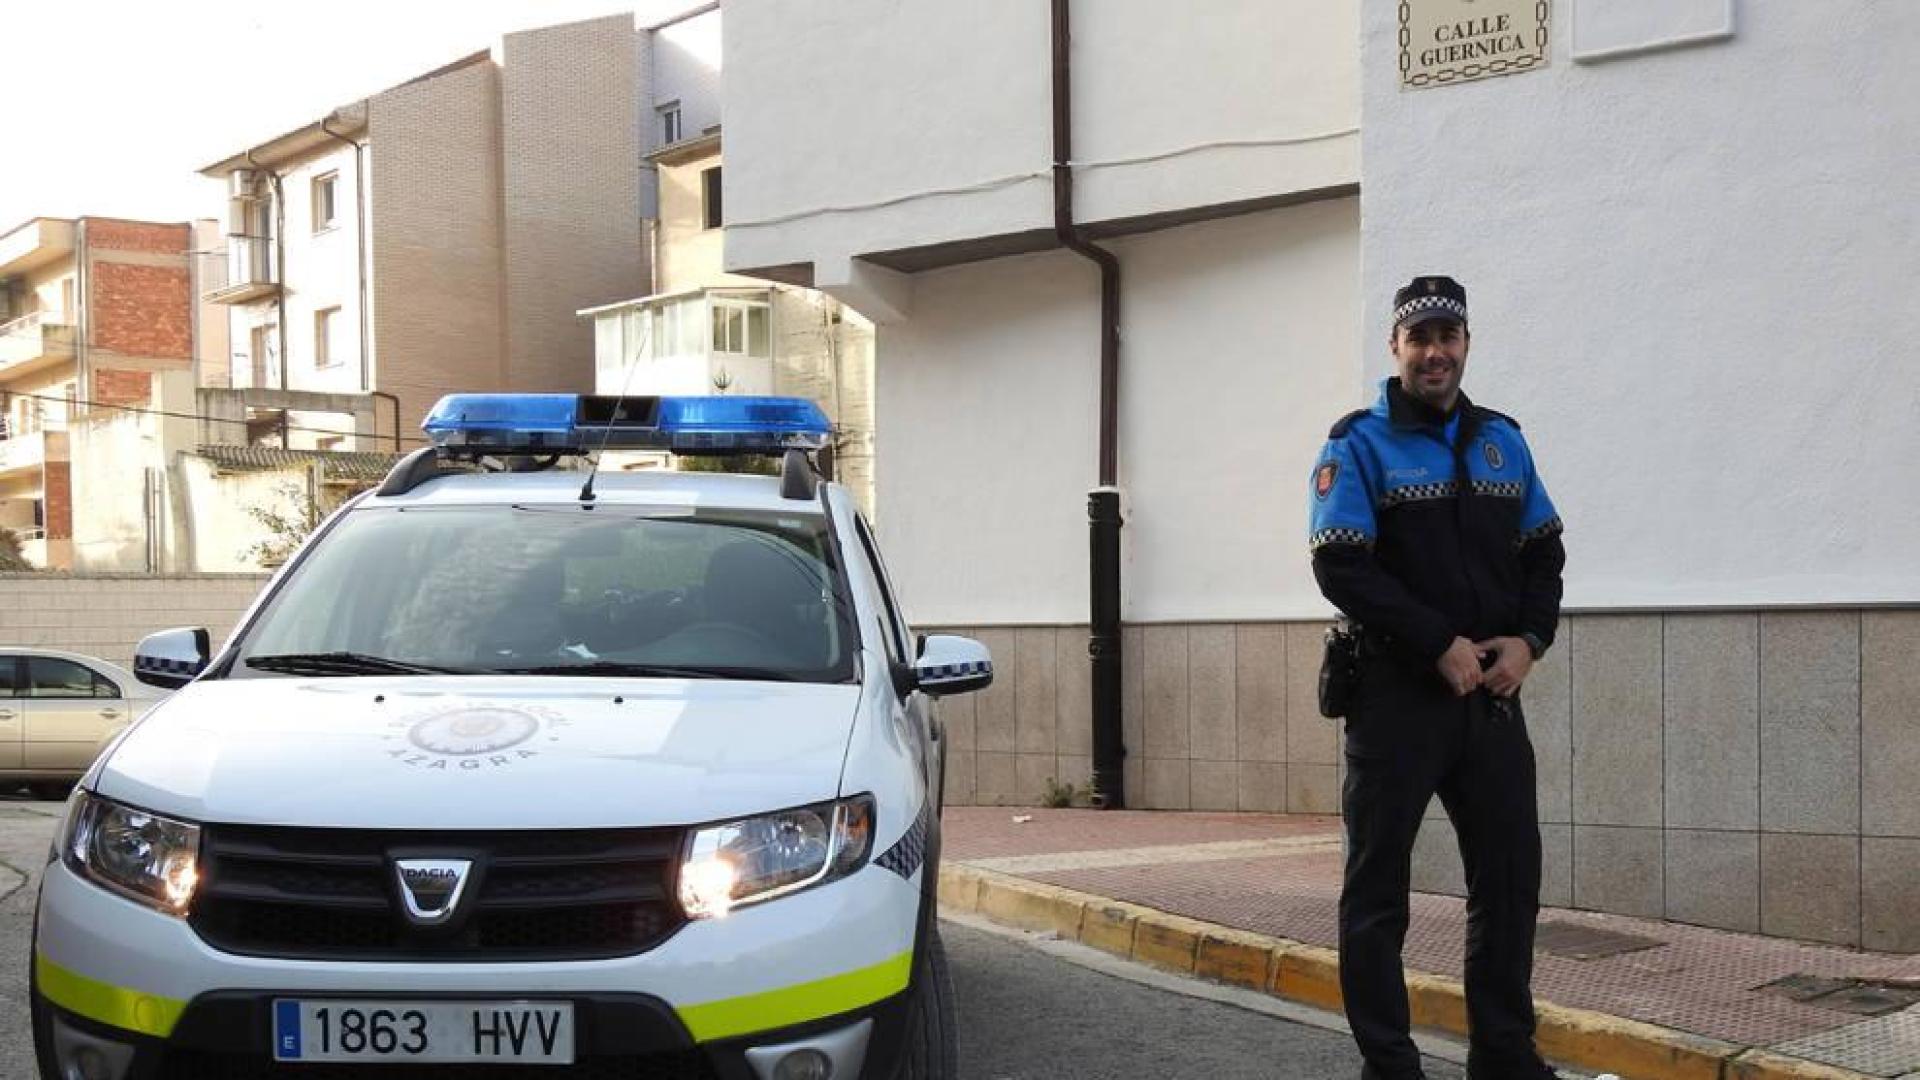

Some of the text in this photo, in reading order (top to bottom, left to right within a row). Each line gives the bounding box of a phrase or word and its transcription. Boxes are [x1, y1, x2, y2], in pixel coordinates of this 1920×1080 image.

[1434, 13, 1510, 42] CALLE
[1420, 33, 1525, 67] GUERNICA
[407, 868, 455, 877] DACIA
[284, 1007, 561, 1055] E 1863 HVV
